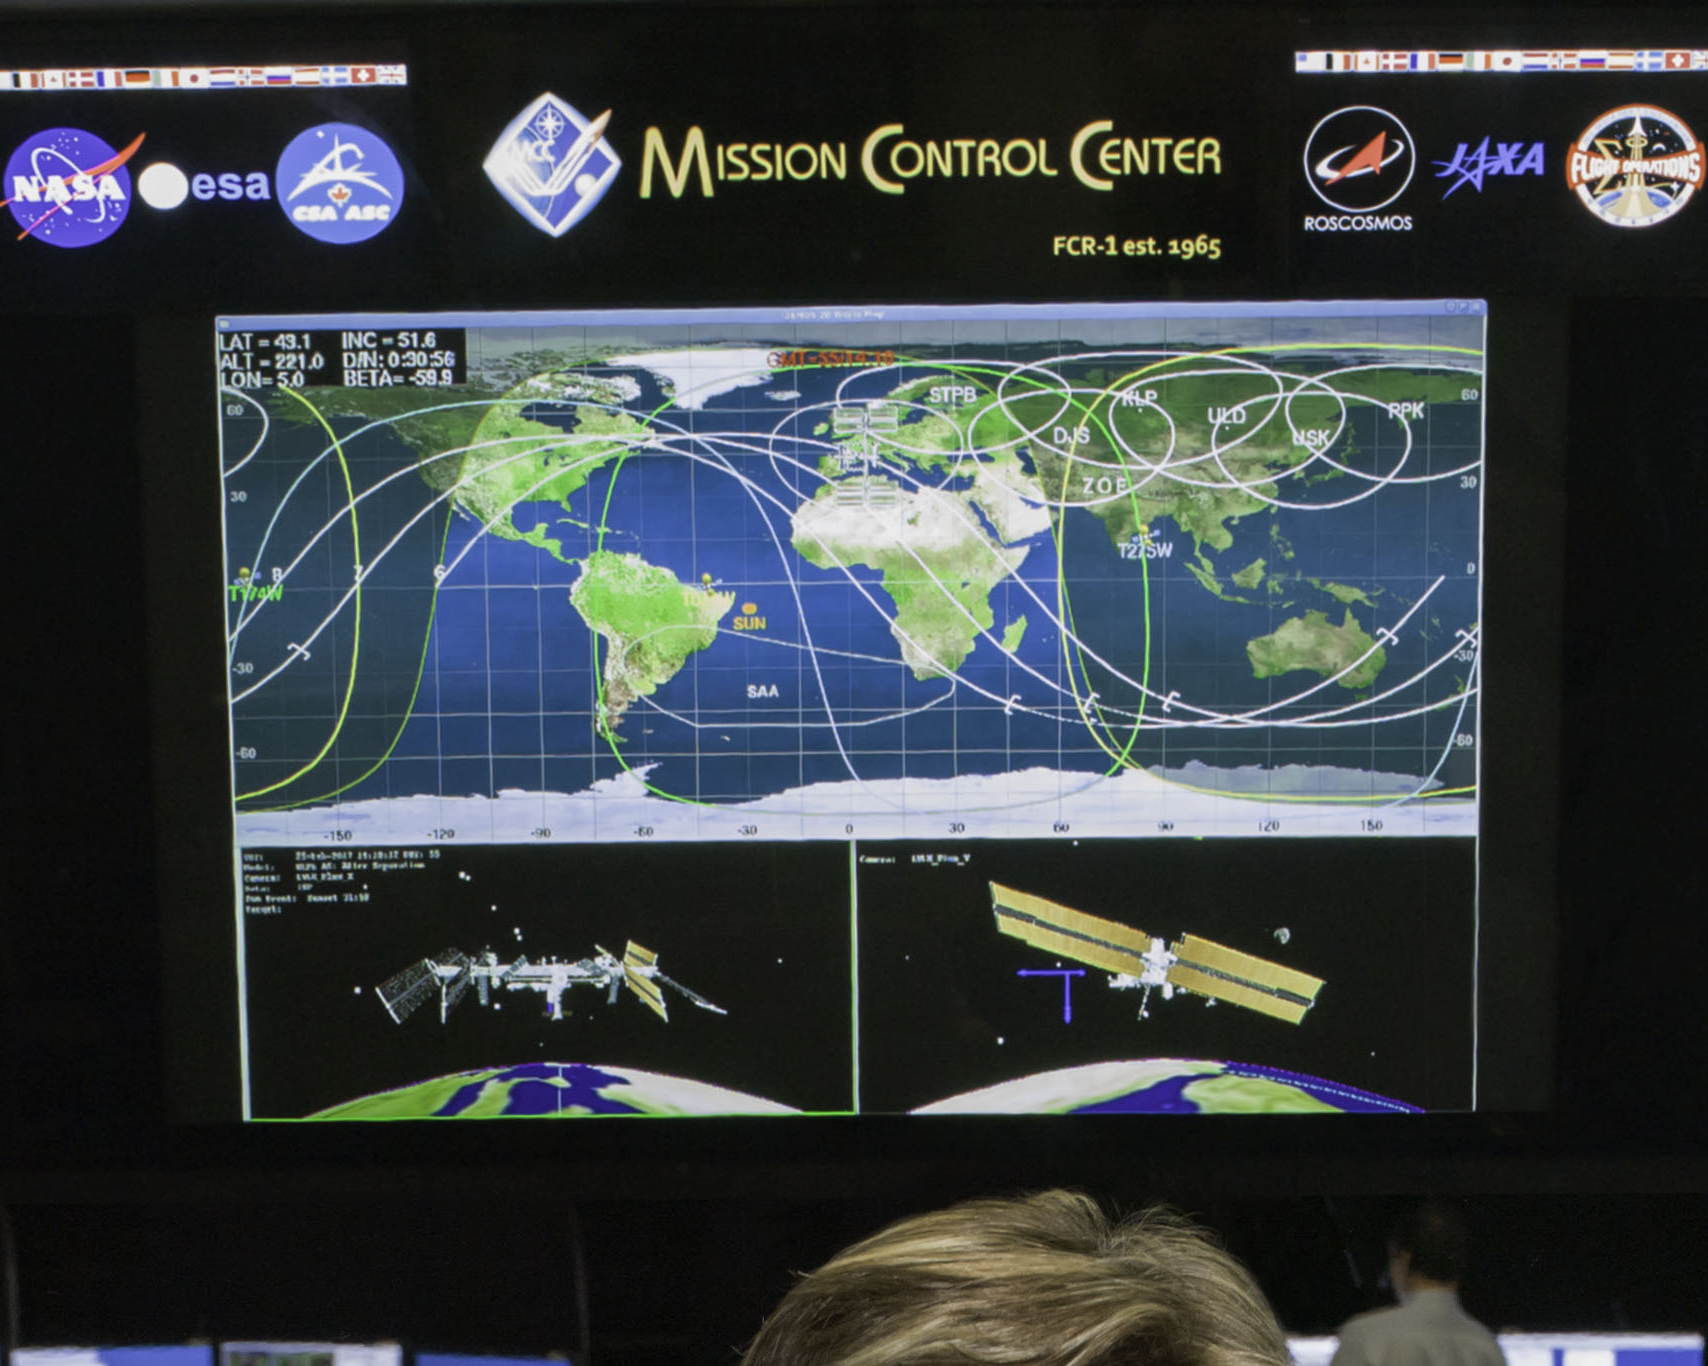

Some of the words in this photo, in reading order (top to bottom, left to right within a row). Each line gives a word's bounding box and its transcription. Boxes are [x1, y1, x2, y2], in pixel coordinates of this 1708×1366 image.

[1431, 137, 1544, 199] JAXA
[1571, 151, 1620, 184] FLIGHT
[1622, 151, 1701, 183] OPERATIONS
[13, 175, 125, 202] NASA
[192, 172, 271, 201] esa
[293, 205, 338, 222] CSA
[344, 205, 390, 222] ASC
[1304, 216, 1412, 231] ROSCOSMOS
[1053, 236, 1117, 258] FCR-1
[1123, 238, 1161, 256] est.
[1168, 236, 1221, 260] 1965
[220, 334, 252, 349] LAT
[274, 334, 310, 349] 43.1
[342, 332, 377, 349] INC
[398, 332, 435, 348] 51.6
[221, 355, 254, 369] ALT
[275, 354, 324, 369] 221.0
[343, 352, 385, 368] D/N:
[277, 373, 304, 387] 5.0
[929, 387, 977, 403] STPB
[1208, 408, 1246, 423] ULD
[231, 492, 247, 501] 30
[733, 617, 766, 630] SUN
[747, 685, 779, 697] SAA
